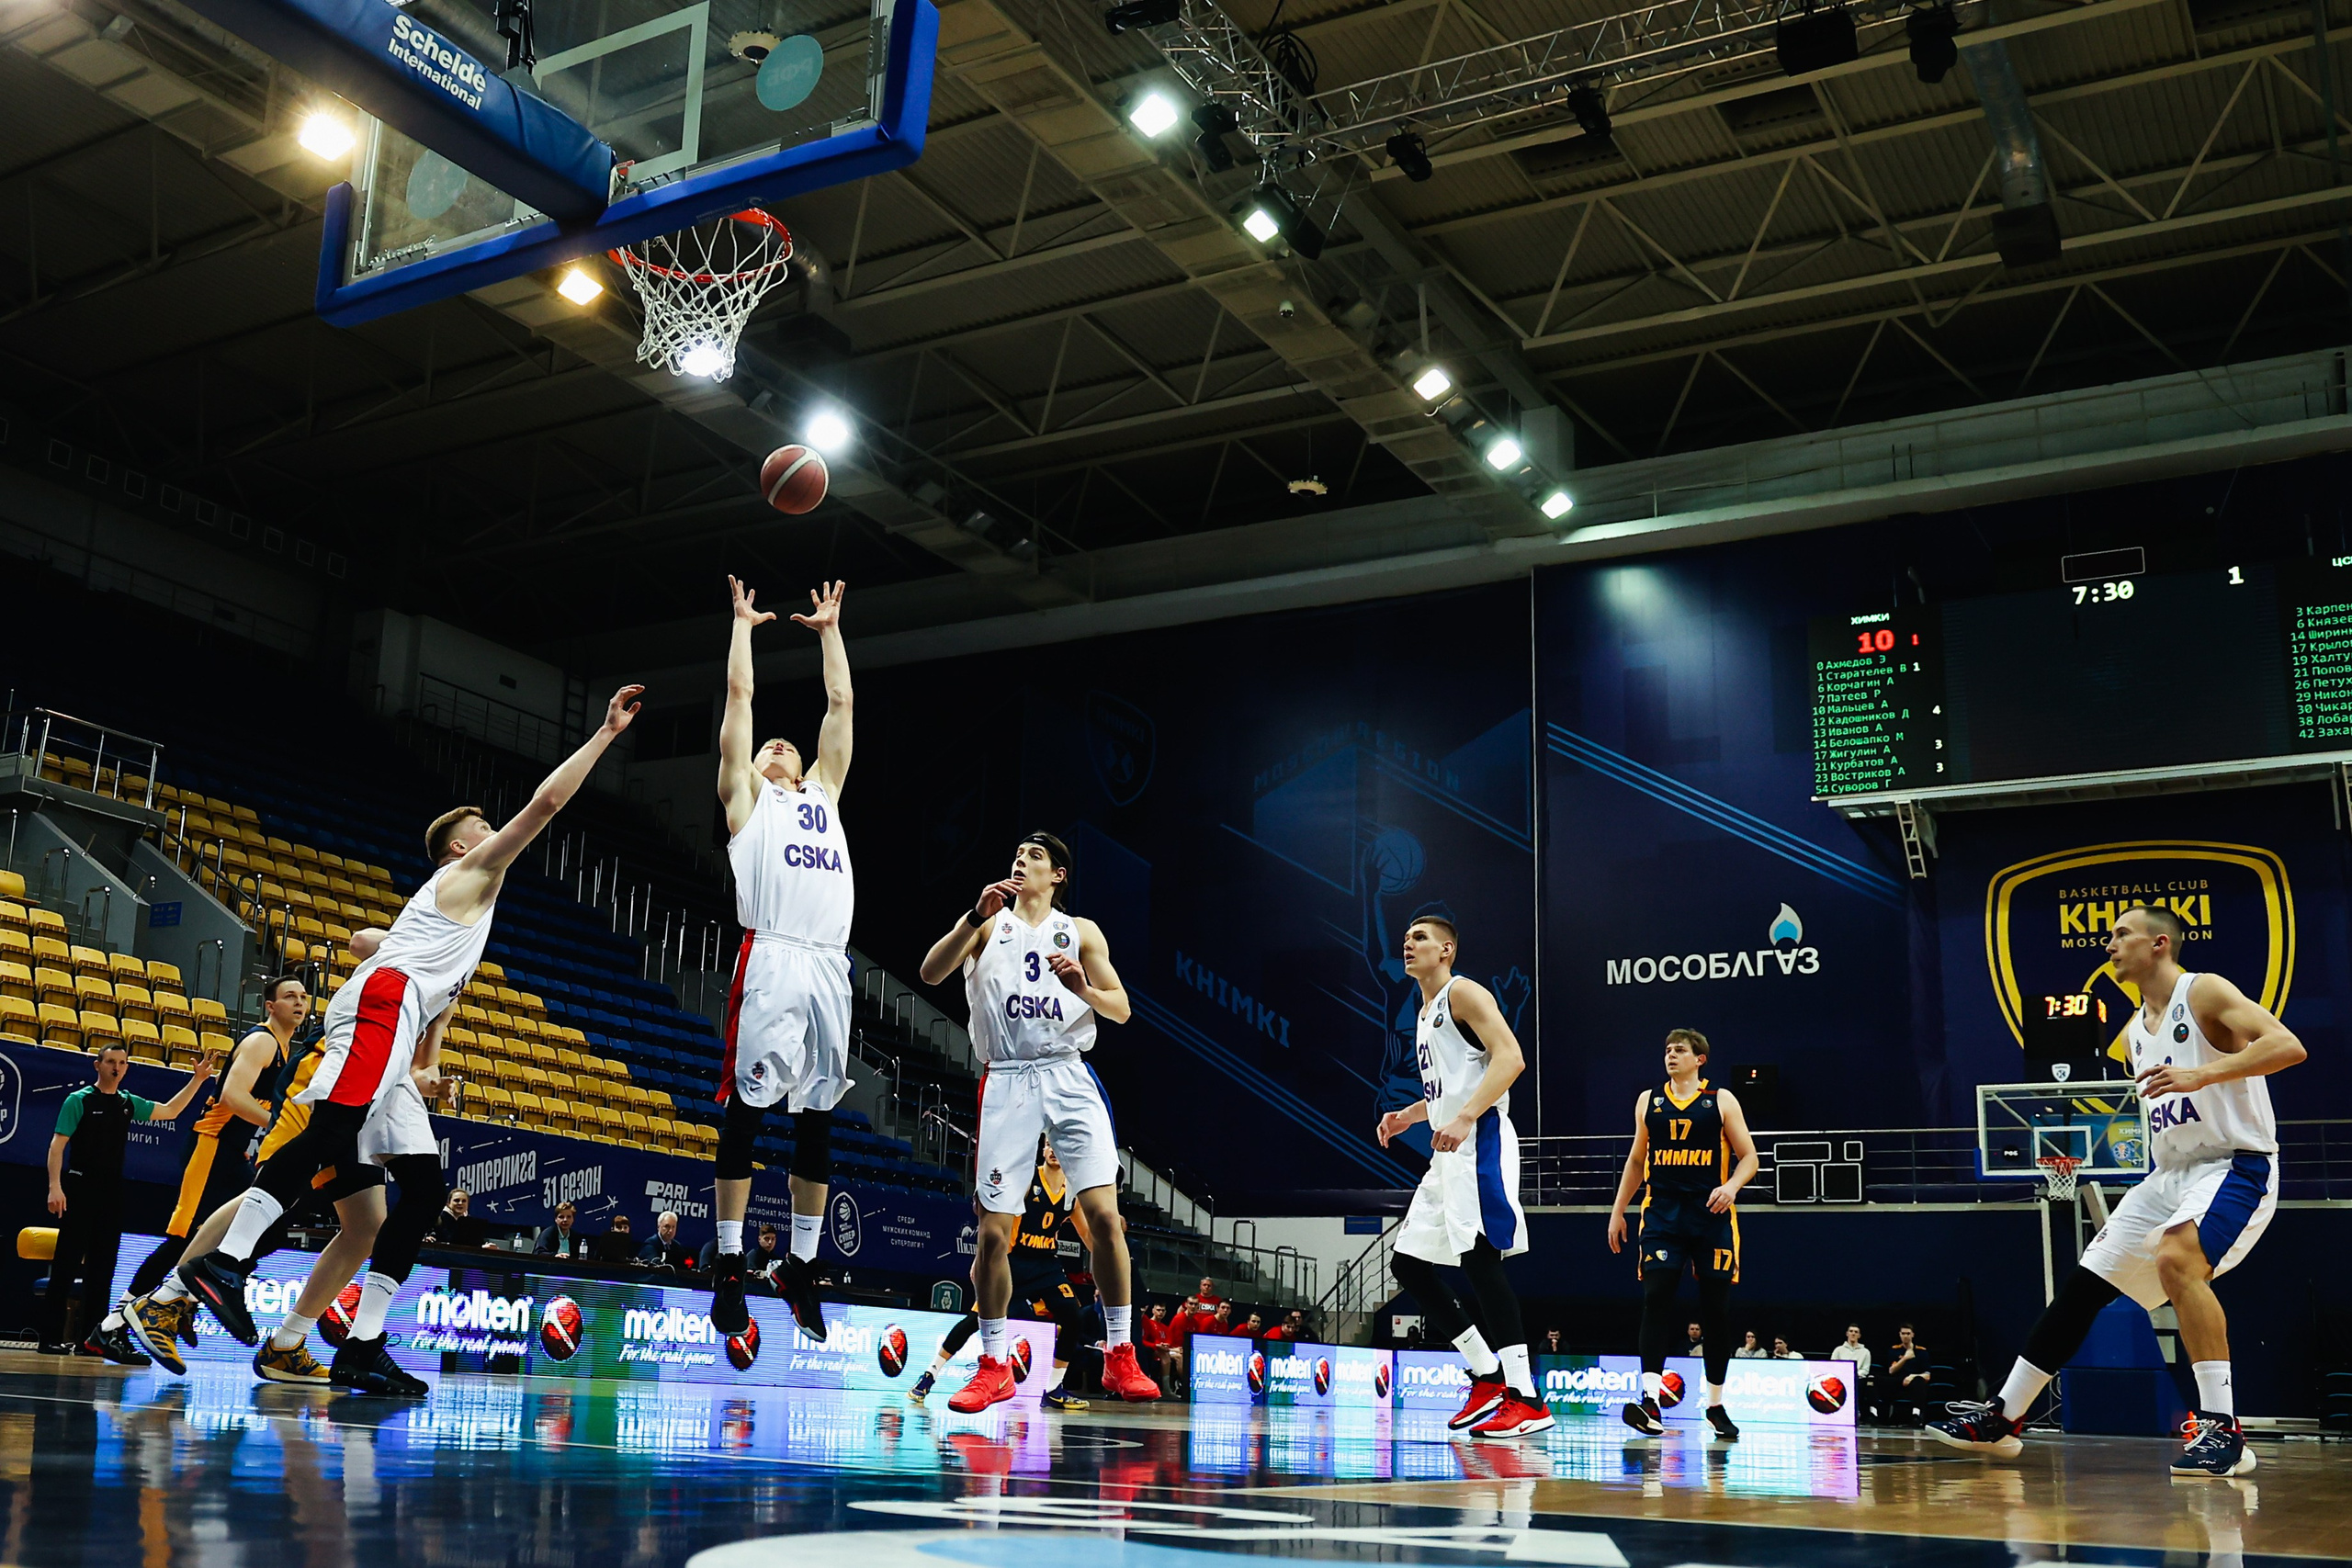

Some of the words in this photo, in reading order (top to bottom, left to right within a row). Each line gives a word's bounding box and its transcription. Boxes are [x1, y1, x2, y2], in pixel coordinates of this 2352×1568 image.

[393, 15, 486, 93] Schelde
[388, 38, 482, 111] International
[2228, 566, 2244, 585] 1
[2072, 581, 2134, 604] 7:30
[1850, 613, 1890, 625] ХИМКИ
[2296, 607, 2303, 617] 3
[2297, 619, 2304, 628] 6
[1858, 629, 1895, 653] 10
[1911, 634, 1919, 646] 1
[2290, 631, 2306, 641] 14
[2291, 643, 2306, 653] 17
[2310, 640, 2352, 652] Крыло
[1816, 661, 1824, 671] 0
[1826, 658, 1872, 670] Ахмедов
[1879, 655, 1886, 664] Э
[2292, 655, 2308, 665] 19
[2311, 652, 2352, 663] Халту
[1817, 672, 1824, 682] 1
[1826, 666, 1894, 681] Старателев
[1899, 663, 1907, 672] В
[1913, 661, 1921, 671] 1
[2293, 668, 2309, 678] 21
[1817, 683, 1825, 693] 6
[1826, 679, 1881, 692] Корчагин
[1886, 676, 1894, 685] А
[2295, 680, 2311, 690] 26
[1818, 694, 1825, 704] 7
[1827, 692, 1868, 703] Патеев
[1873, 689, 1882, 698] Р
[2296, 692, 2311, 702] 29
[1813, 706, 1826, 716] 10
[1827, 702, 1875, 714] Мальцев
[1881, 700, 1889, 708] А
[1813, 717, 1826, 727] 12
[1828, 712, 1895, 725] Кадошников
[1902, 709, 1910, 719] Д
[1932, 705, 1941, 715] 4
[2297, 704, 2312, 715] 30
[1814, 728, 1826, 738] 13
[1828, 725, 1869, 737] Иванов
[1875, 723, 1883, 732] А
[2298, 716, 2313, 727] 38
[2317, 713, 2352, 725] Лоба
[1814, 740, 1826, 749] 14
[1829, 735, 1890, 748] Белошапко
[1895, 732, 1904, 741] М
[2299, 728, 2314, 739] 42
[2318, 727, 2352, 737] Заха
[1814, 750, 1827, 761] 17
[1829, 747, 1877, 759] Жигулин
[1883, 745, 1891, 754] А
[1935, 739, 1943, 750] 3
[1815, 762, 1827, 772] 21
[1830, 758, 1884, 771] Курбатов
[1890, 756, 1898, 764] А
[1815, 773, 1828, 783] 23
[1831, 768, 1892, 782] Востриков
[1898, 766, 1905, 775] А
[1936, 762, 1944, 773] 3
[1815, 784, 1828, 795] 54
[1831, 782, 1879, 794] Суворов
[1885, 779, 1892, 788] Г
[797, 803, 827, 833] 30
[784, 844, 843, 874] CSKA
[2059, 883, 2161, 898] BASKETBALL
[2167, 879, 2208, 891] CLUB
[2060, 895, 2211, 934] KHKI
[1024, 951, 1040, 982] 3
[1607, 947, 1820, 985] МОСОБЛГАЗ
[1005, 994, 1064, 1021] CSKA
[1176, 950, 1290, 1048] KHIMKI
[2044, 995, 2088, 1016] 7:30
[1424, 1077, 1442, 1103] SKA
[2151, 1097, 2202, 1134] SKA
[1668, 1118, 1693, 1141] 17
[1654, 1149, 1713, 1166] ХИМКИ
[543, 1175, 557, 1209] 31
[650, 1181, 689, 1200] PARI
[657, 1198, 708, 1219] MATCH
[1042, 1212, 1054, 1229] 0
[1713, 1247, 1733, 1271] 17
[416, 1289, 530, 1334] molten
[624, 1306, 717, 1344] molten
[412, 1330, 434, 1349] For
[434, 1331, 458, 1350] the
[460, 1333, 491, 1353] real
[488, 1340, 528, 1361] game
[618, 1343, 639, 1362] For
[639, 1342, 659, 1361] the
[659, 1347, 685, 1363] real
[683, 1352, 716, 1370] game
[789, 1354, 807, 1371] For
[807, 1355, 822, 1370] the
[824, 1358, 844, 1371] real
[1195, 1349, 1243, 1376] molten
[1271, 1355, 1311, 1380] molten
[1334, 1359, 1372, 1382] molten
[1403, 1363, 1473, 1386] molte
[1546, 1367, 1637, 1392] molten
[1399, 1387, 1417, 1398] For
[1418, 1388, 1435, 1398] the
[1437, 1389, 1457, 1399] real
[1544, 1391, 1563, 1403] For
[1562, 1391, 1580, 1403] the
[1581, 1392, 1607, 1404] real
[1605, 1395, 1638, 1408] game
